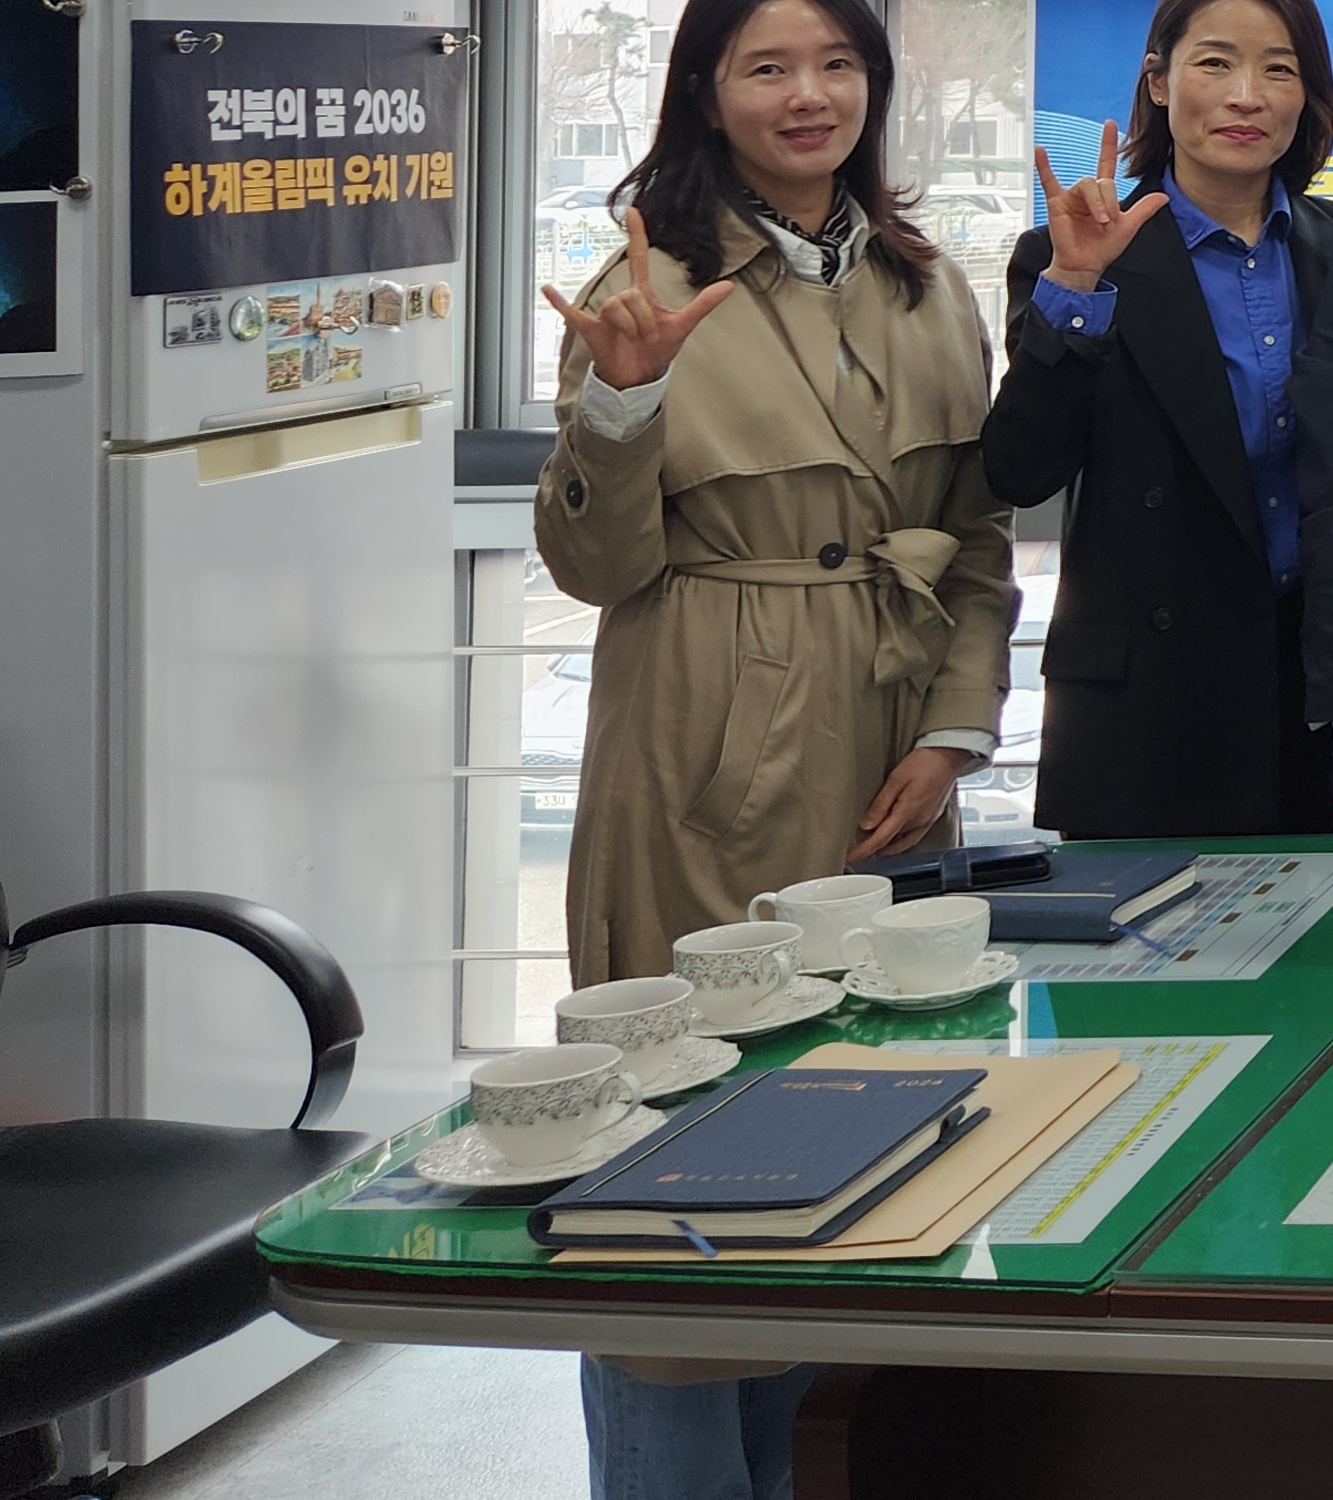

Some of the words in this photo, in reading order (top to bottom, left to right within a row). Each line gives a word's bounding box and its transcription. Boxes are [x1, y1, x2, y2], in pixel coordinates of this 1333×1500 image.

[207, 87, 307, 142] 전북의
[315, 87, 347, 137] 꿈
[353, 88, 427, 136] 2036
[163, 156, 336, 217] 하계올림픽
[343, 153, 399, 207] 유치
[404, 150, 455, 200] 기원
